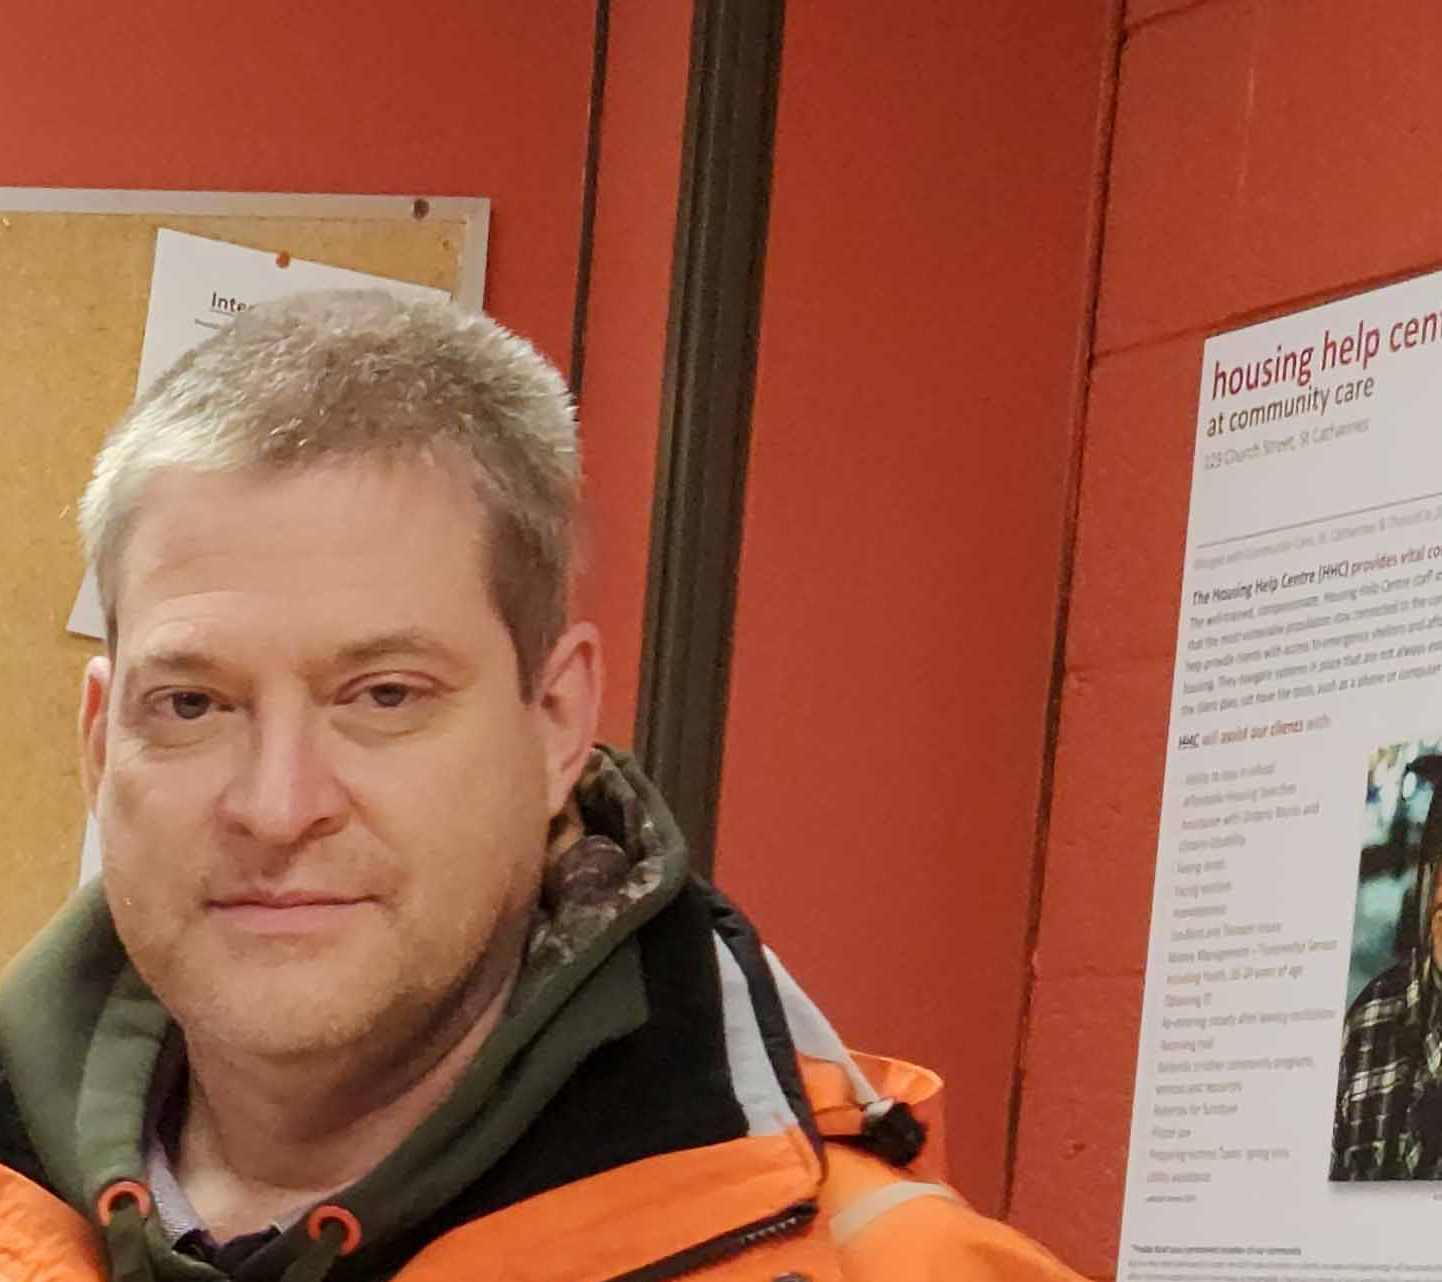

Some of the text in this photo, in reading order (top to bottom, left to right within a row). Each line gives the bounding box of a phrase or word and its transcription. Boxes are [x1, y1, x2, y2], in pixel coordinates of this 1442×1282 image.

[1212, 345, 1315, 400] housing
[1321, 320, 1381, 371] help
[1206, 375, 1375, 438] at community care
[1212, 583, 1253, 602] Housing
[1254, 577, 1279, 594] Help
[1281, 570, 1316, 589] Centre
[1350, 551, 1398, 576] provides
[1401, 546, 1426, 564] vital
